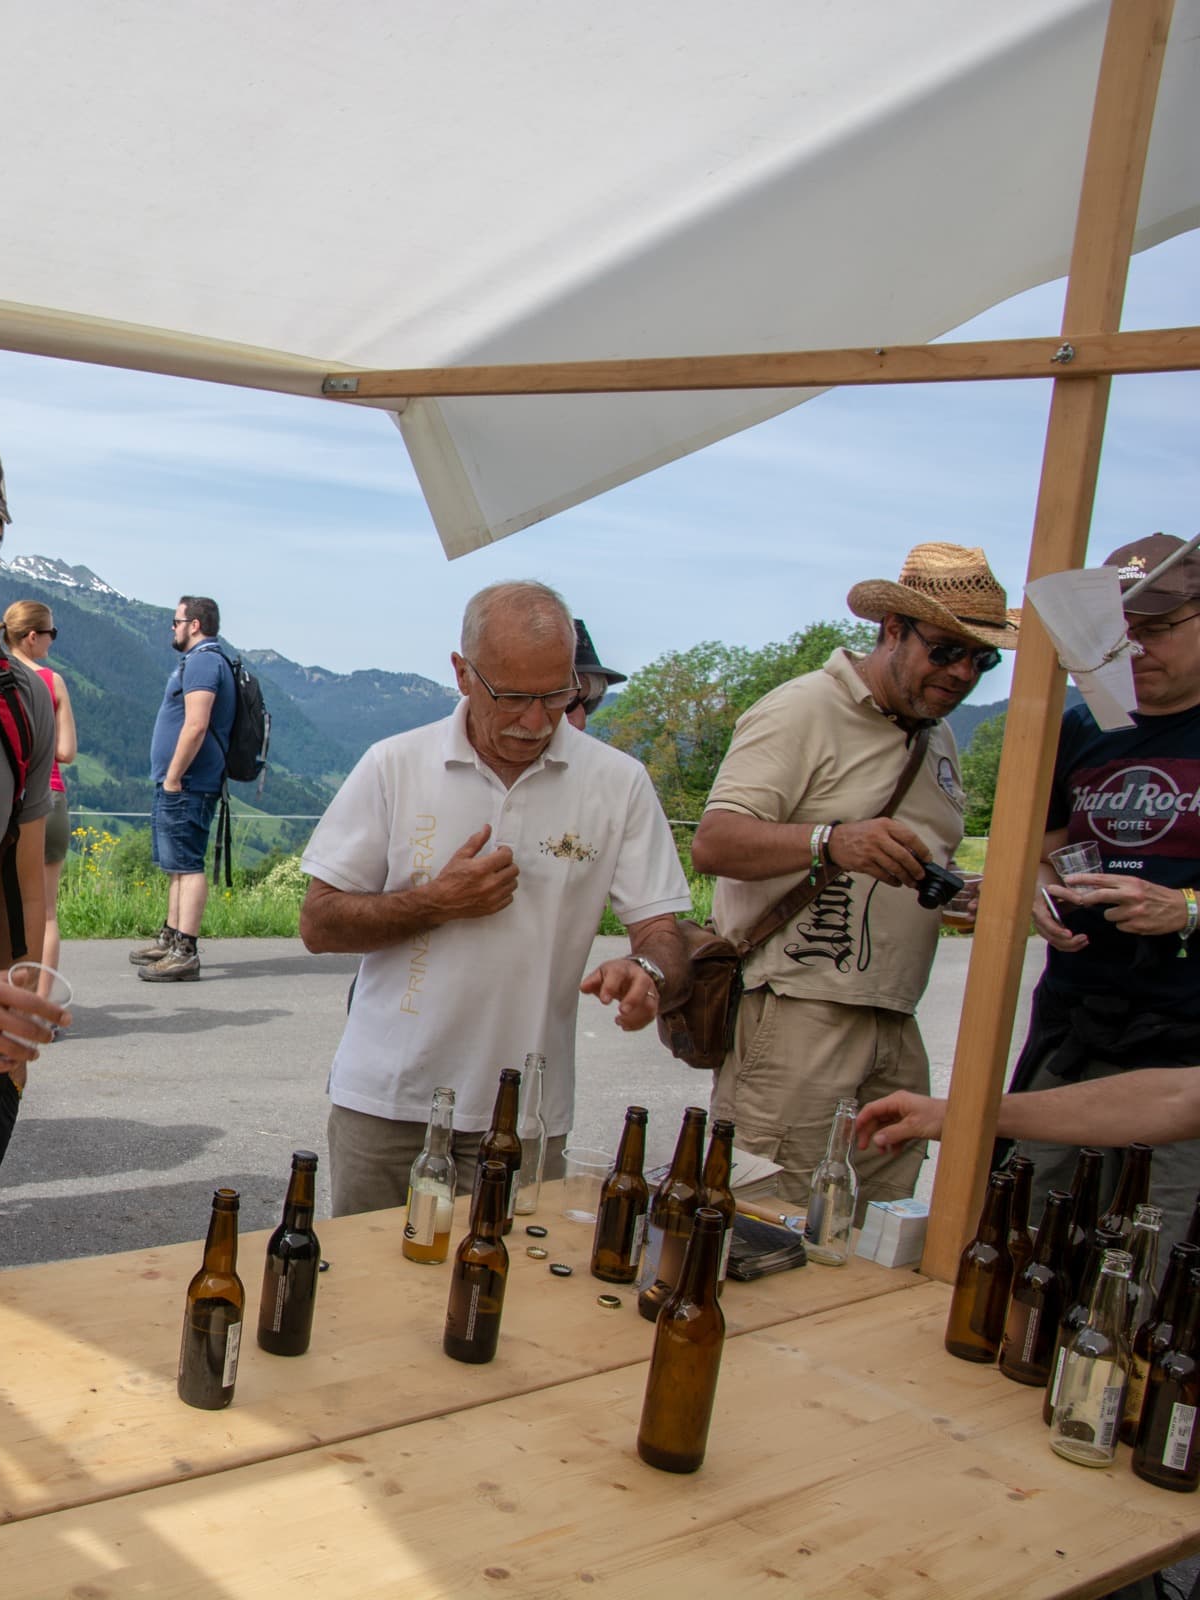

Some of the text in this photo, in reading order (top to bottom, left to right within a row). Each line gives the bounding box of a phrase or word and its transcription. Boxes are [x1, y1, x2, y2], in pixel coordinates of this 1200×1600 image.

[1072, 783, 1135, 813] Hard
[1107, 820, 1152, 831] HOTEL
[1108, 861, 1144, 869] DAVOS
